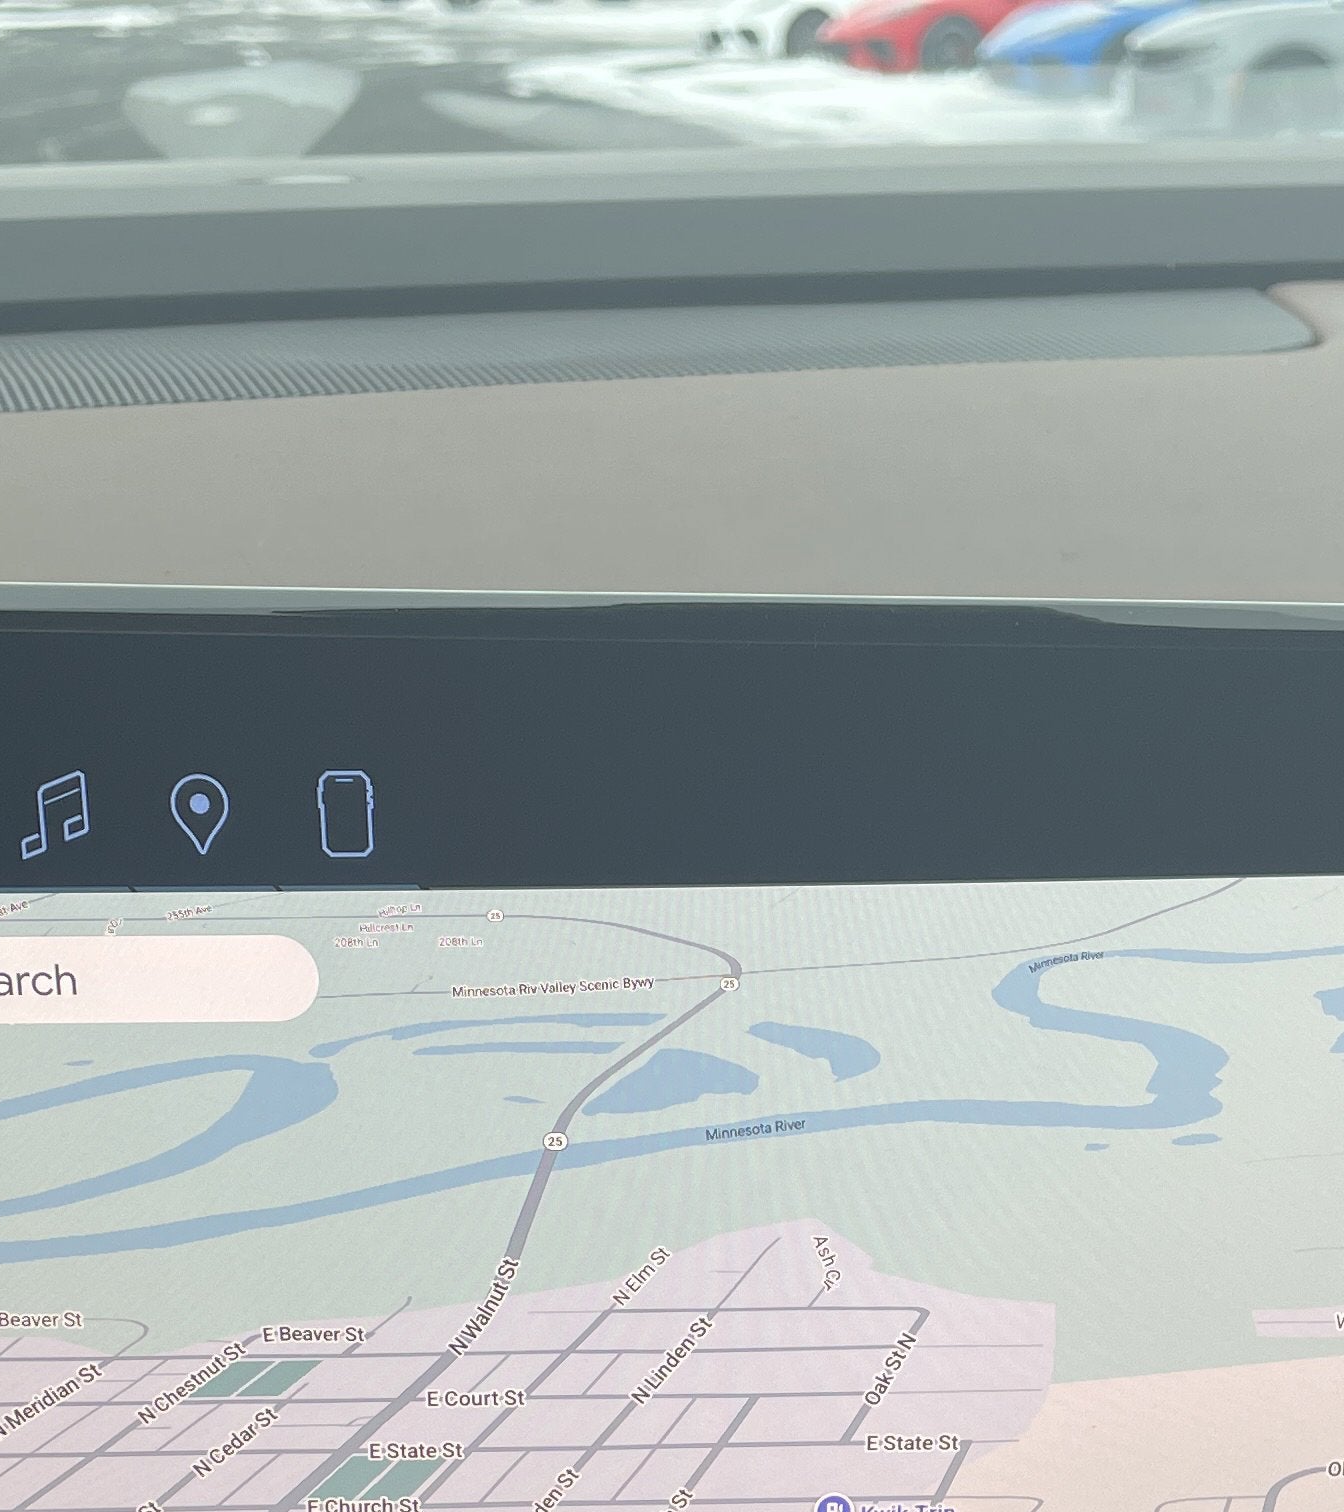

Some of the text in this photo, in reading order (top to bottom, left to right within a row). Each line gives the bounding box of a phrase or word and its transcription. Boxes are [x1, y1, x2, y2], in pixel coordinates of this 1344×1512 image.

[10, 900, 29, 913] Ave
[367, 937, 379, 947] Ln
[1029, 950, 1105, 973] Minnesota River
[452, 977, 655, 998] Minnesota Riv Valley Scenic Bywy
[705, 1118, 806, 1141] Minnesota River
[548, 1136, 563, 1147] 25
[813, 1236, 841, 1292] Ash Cir
[613, 1247, 671, 1306] N Elm St
[448, 1258, 519, 1356] N Walnut St
[63, 1312, 83, 1328] St
[263, 1326, 366, 1342] E Beaver St
[631, 1316, 713, 1405] N Linden St
[864, 1332, 917, 1406] Oak St N
[137, 1341, 247, 1425] N Chestnut St
[5, 1377, 79, 1428] Meridian
[78, 1362, 102, 1384] St
[427, 1390, 525, 1406] E Court St
[192, 1407, 279, 1478] N Cedar St
[369, 1443, 463, 1459] E State St
[867, 1434, 959, 1451] E State St
